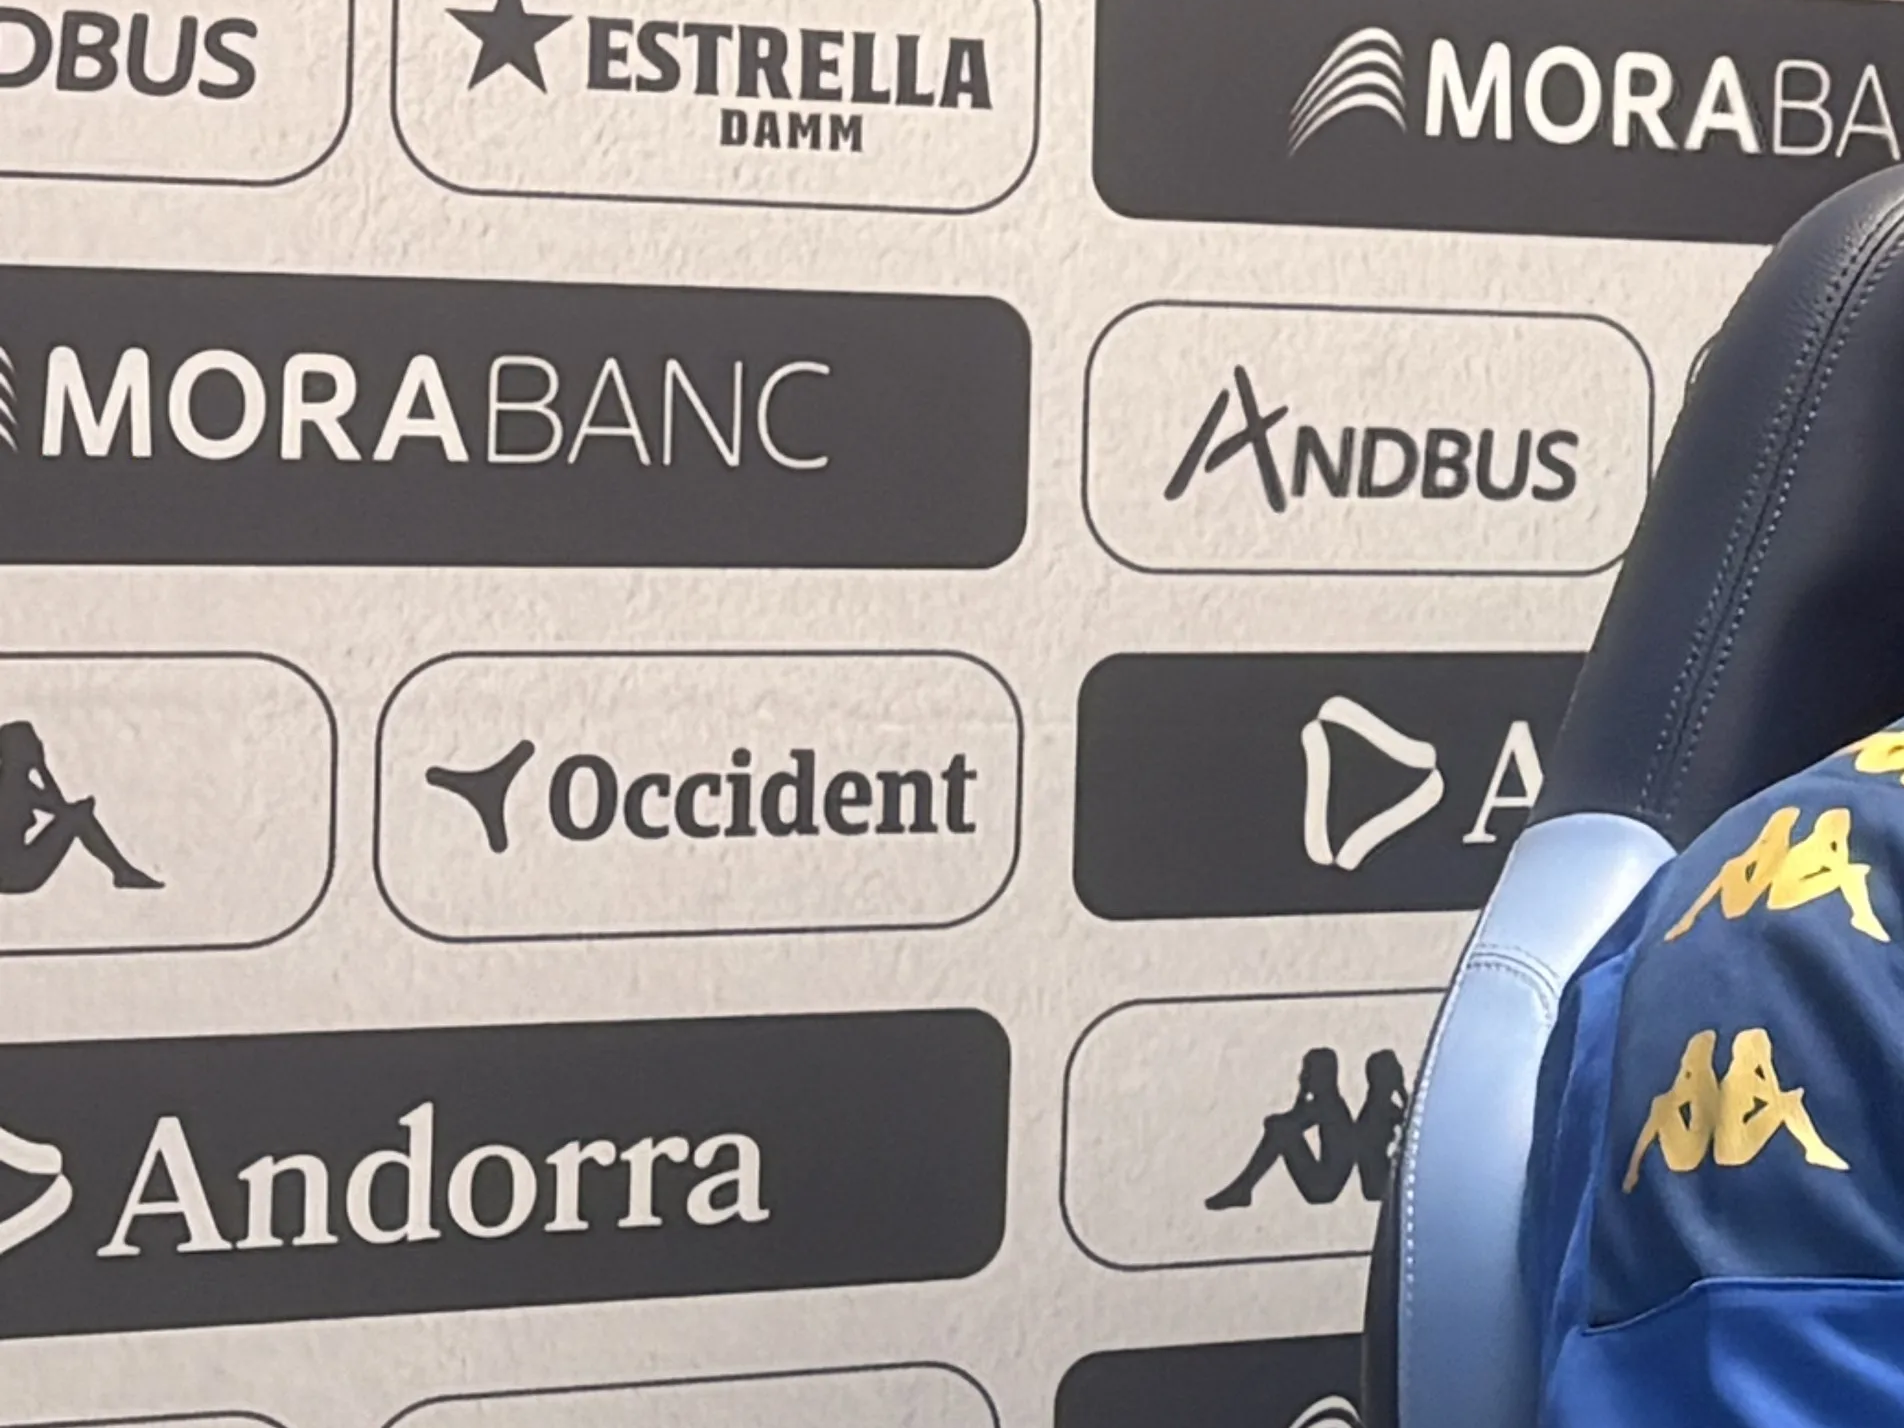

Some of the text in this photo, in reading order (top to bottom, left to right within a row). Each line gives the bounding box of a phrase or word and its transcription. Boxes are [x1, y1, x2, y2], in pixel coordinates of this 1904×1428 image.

[0, 5, 258, 100] DBUS
[587, 17, 992, 109] ESTRELLA
[721, 109, 862, 152] DAMM
[43, 346, 829, 468] MORABANC
[1164, 366, 1578, 512] ANDBUS
[549, 748, 977, 840] Occident
[98, 1103, 769, 1256] Andorra
